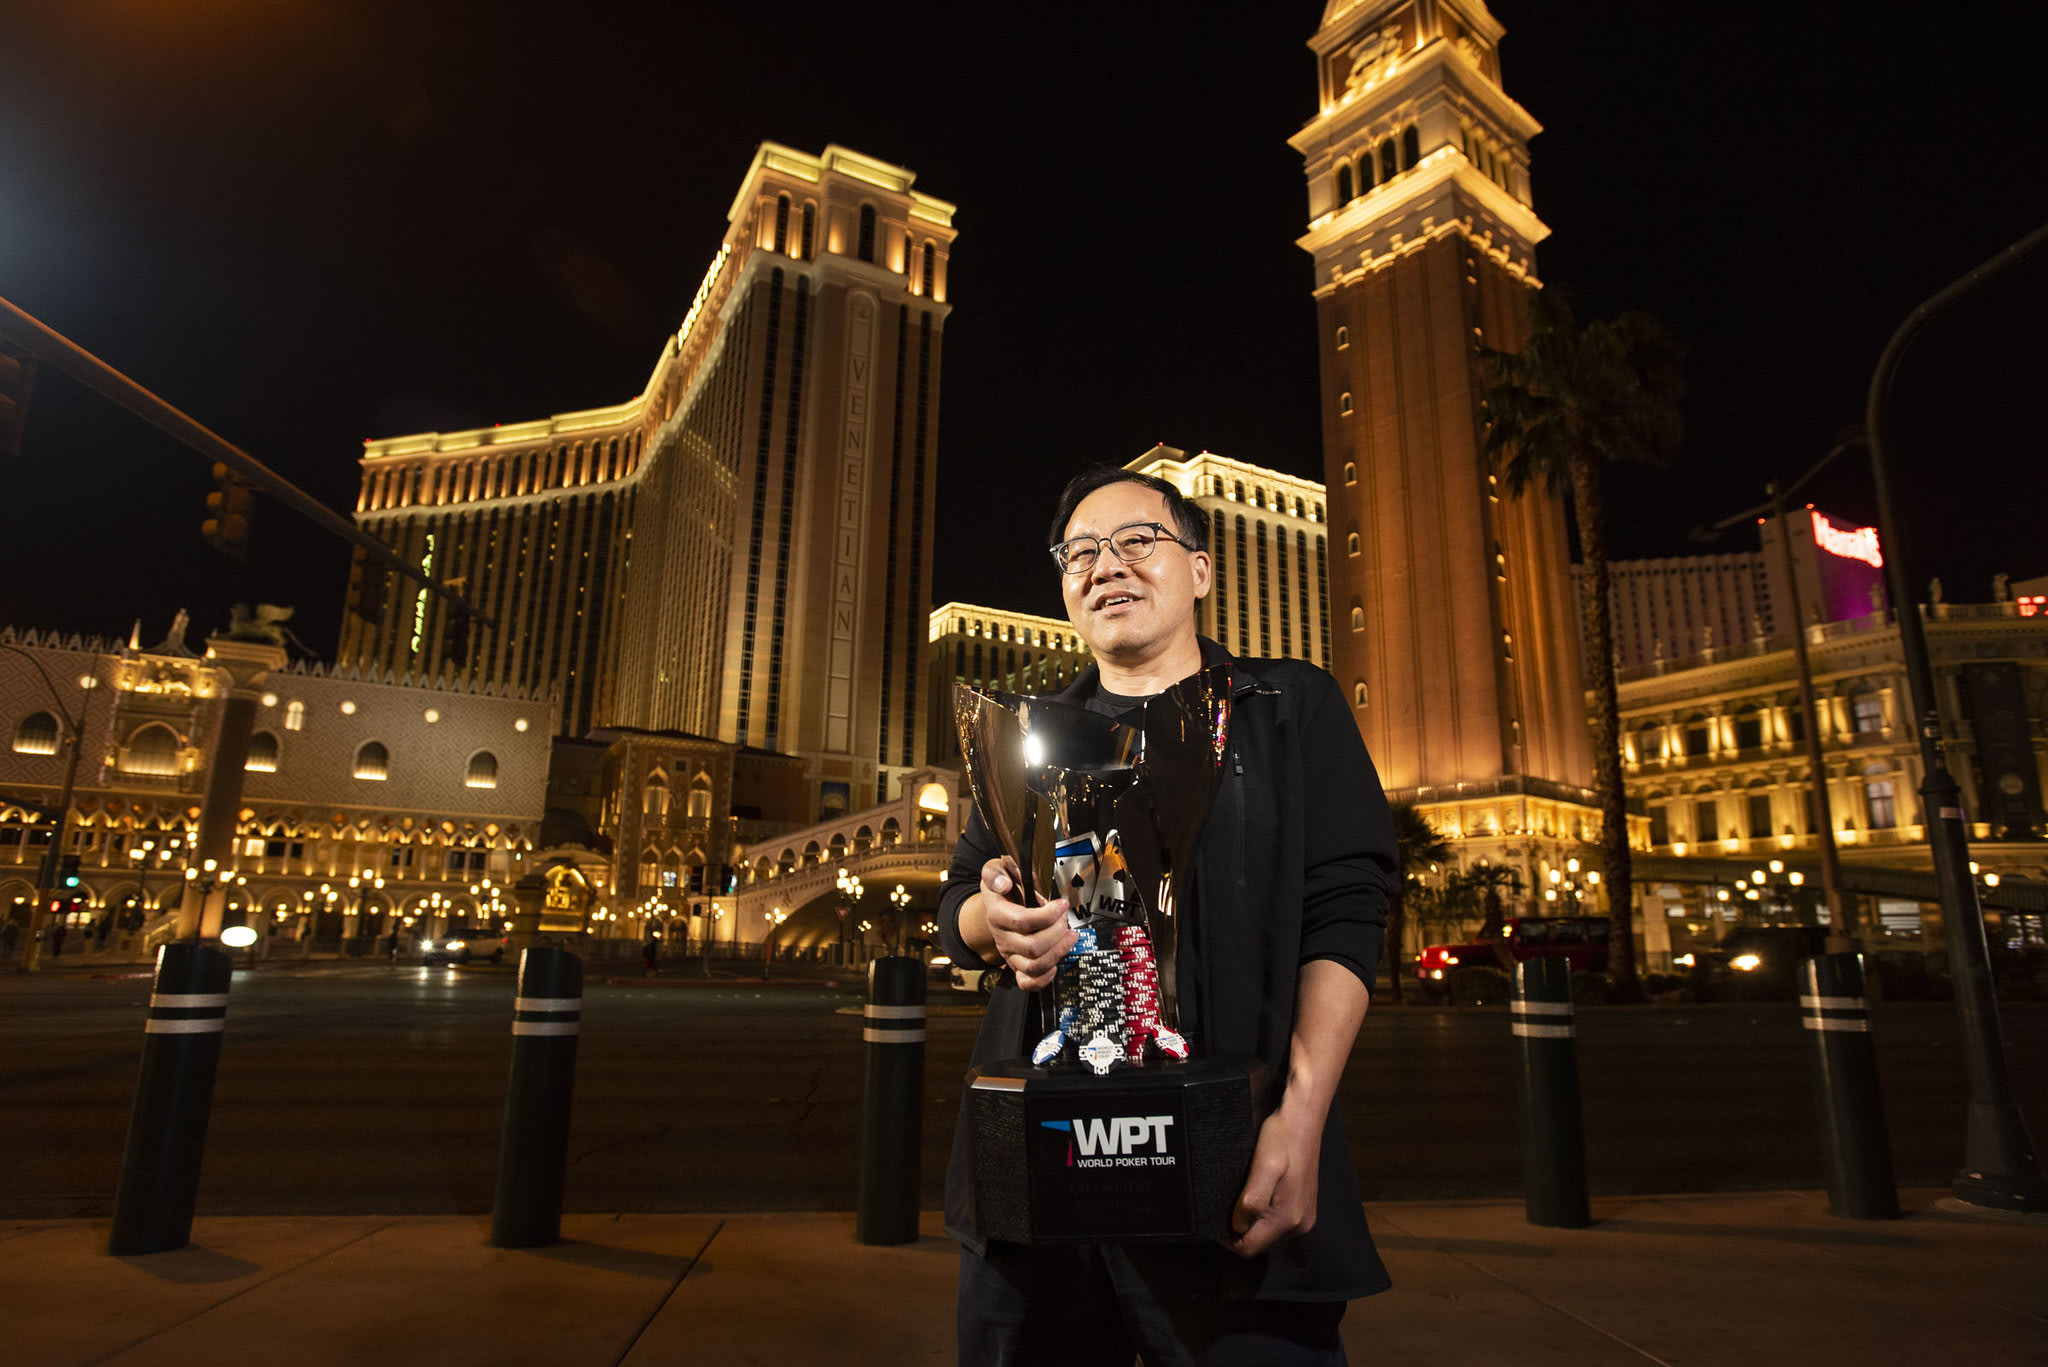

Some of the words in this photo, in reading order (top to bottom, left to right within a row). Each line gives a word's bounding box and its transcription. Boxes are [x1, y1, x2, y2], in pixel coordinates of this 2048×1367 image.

[837, 358, 865, 632] VENETIAN
[1099, 894, 1138, 918] WPT
[1072, 1115, 1174, 1156] WPT
[1077, 1158, 1113, 1168] WORLD
[1116, 1157, 1147, 1167] POKER
[1149, 1156, 1176, 1166] TOUR
